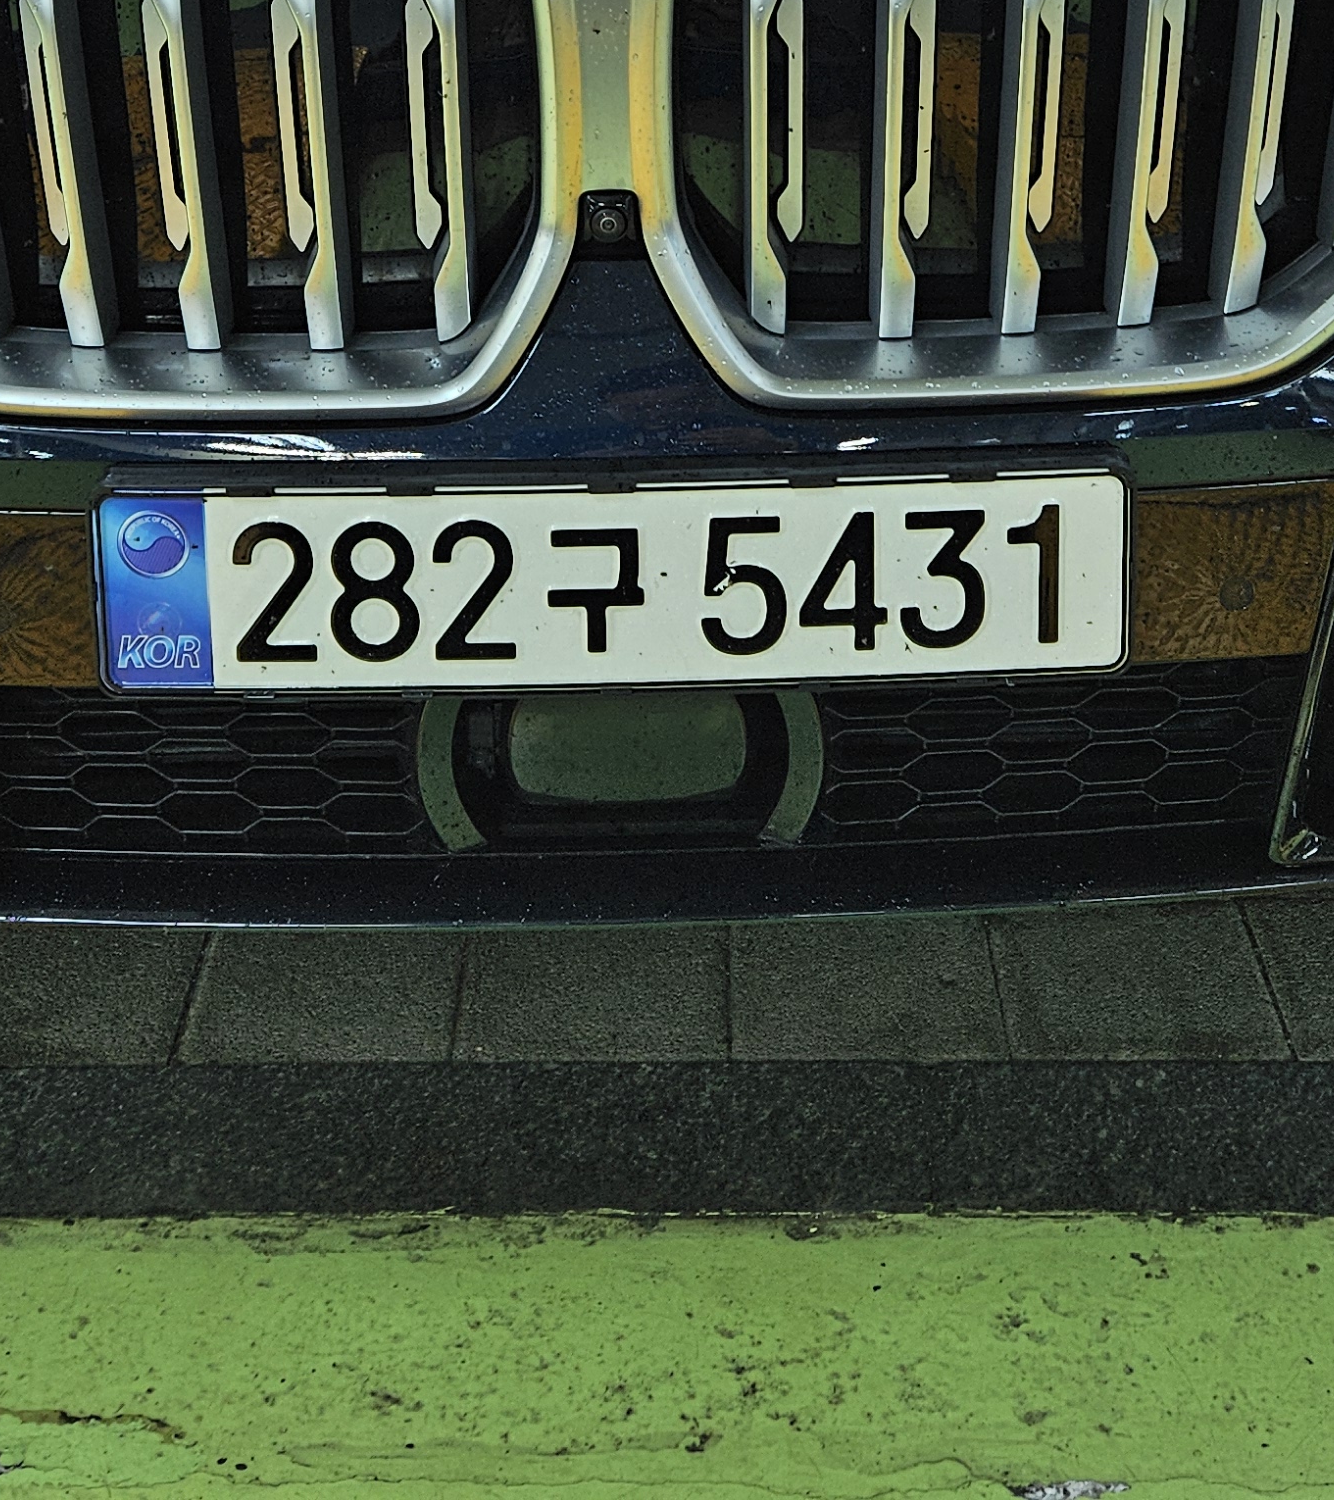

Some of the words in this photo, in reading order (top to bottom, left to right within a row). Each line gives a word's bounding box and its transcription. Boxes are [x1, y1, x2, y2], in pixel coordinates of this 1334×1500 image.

[231, 518, 646, 664] 282구
[700, 503, 1061, 657] 5431
[117, 634, 201, 669] KOR
